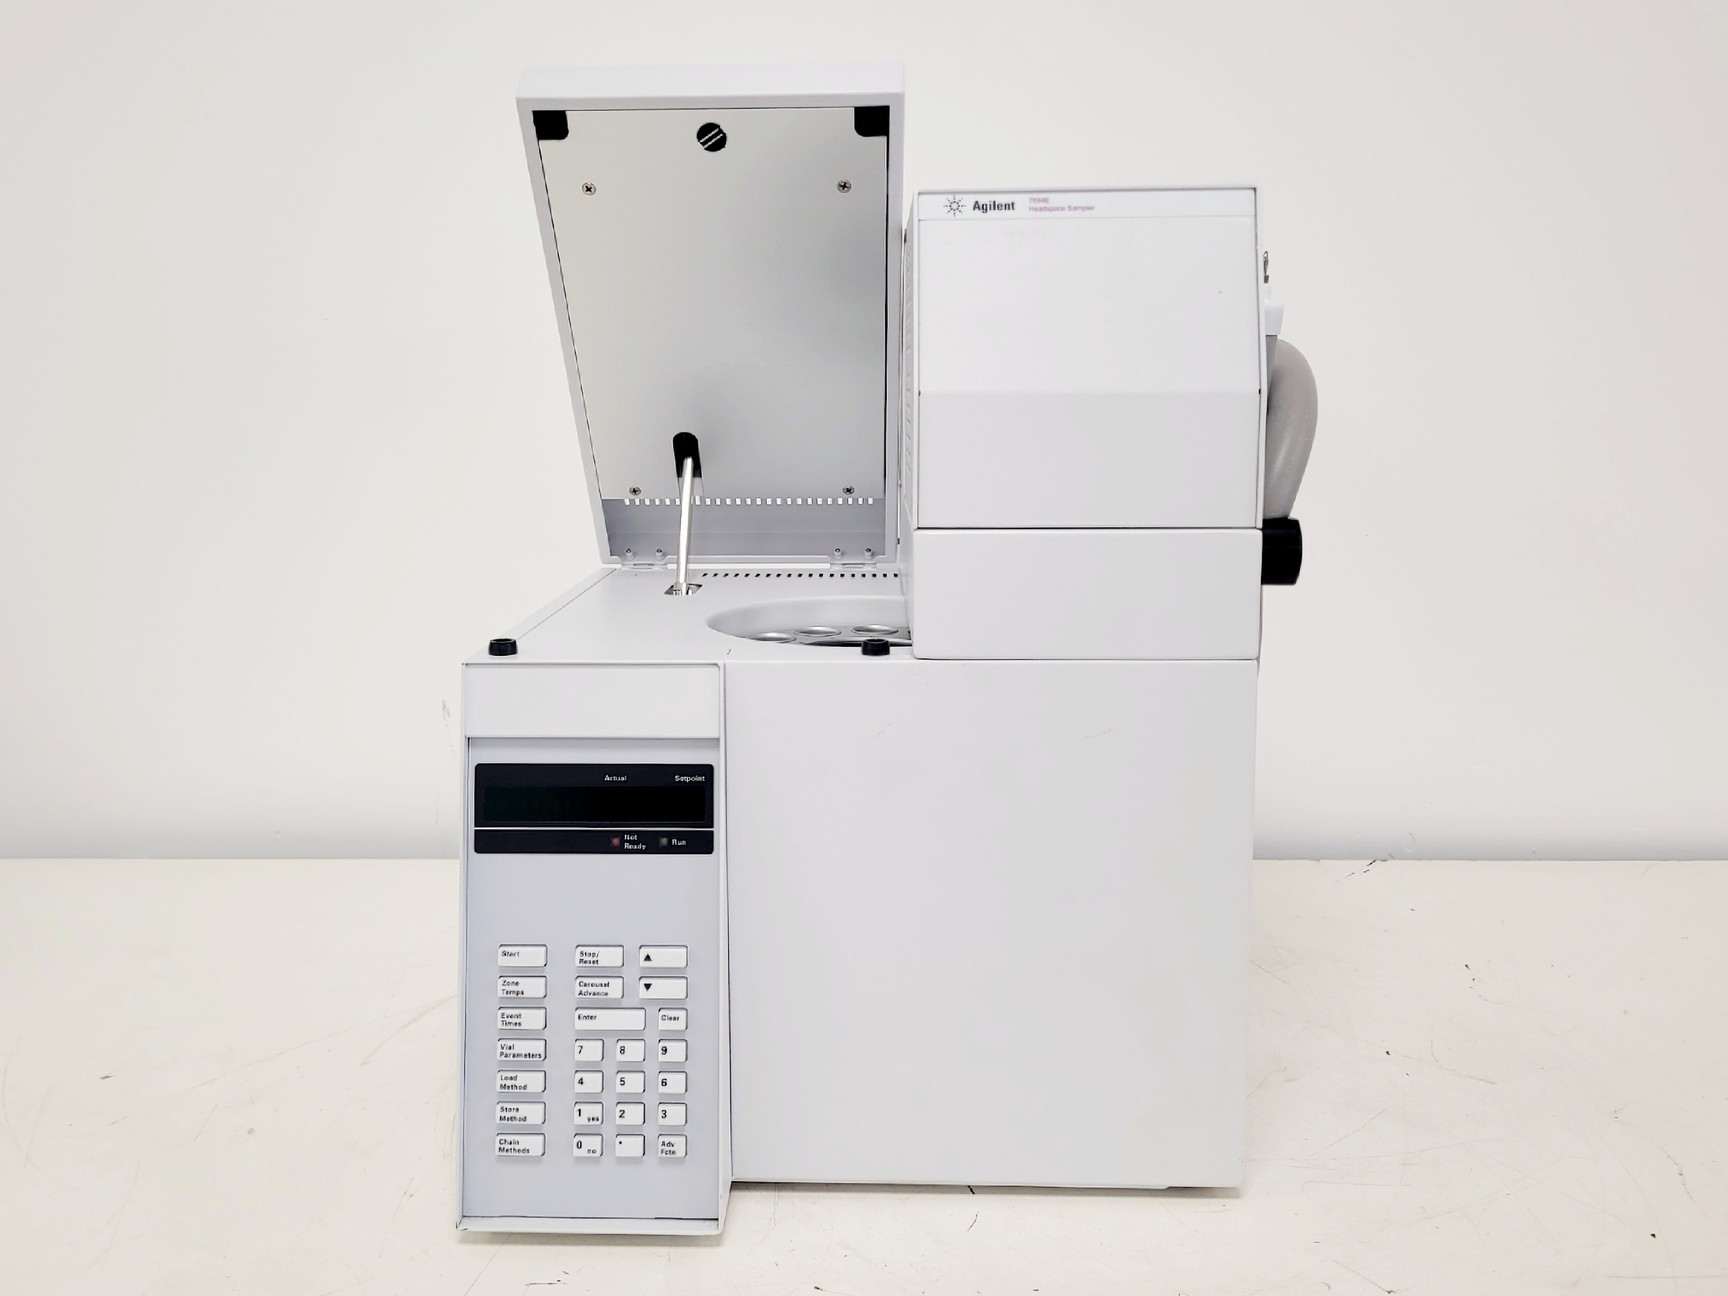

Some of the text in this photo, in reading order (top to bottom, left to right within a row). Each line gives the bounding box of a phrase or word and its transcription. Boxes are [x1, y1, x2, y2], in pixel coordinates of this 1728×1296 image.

[972, 200, 1016, 213] Agilent
[1029, 205, 1095, 213] Headspace Sampler
[674, 775, 705, 783] Setpoint
[624, 842, 647, 850] Ready
[501, 988, 525, 996] Temps
[577, 1013, 598, 1021] Enter
[661, 1014, 680, 1022] Clear
[578, 1045, 584, 1054] 7
[619, 1045, 626, 1055] 8
[661, 1046, 668, 1055] 9
[499, 1051, 542, 1059] Parameters
[577, 1077, 584, 1086] 4
[619, 1077, 626, 1086] 5
[661, 1078, 668, 1087] 6
[618, 1109, 626, 1119] 2
[661, 1109, 668, 1119] 3
[576, 1140, 583, 1150] 0
[661, 1140, 676, 1148] Adv
[498, 1147, 530, 1155] Methods
